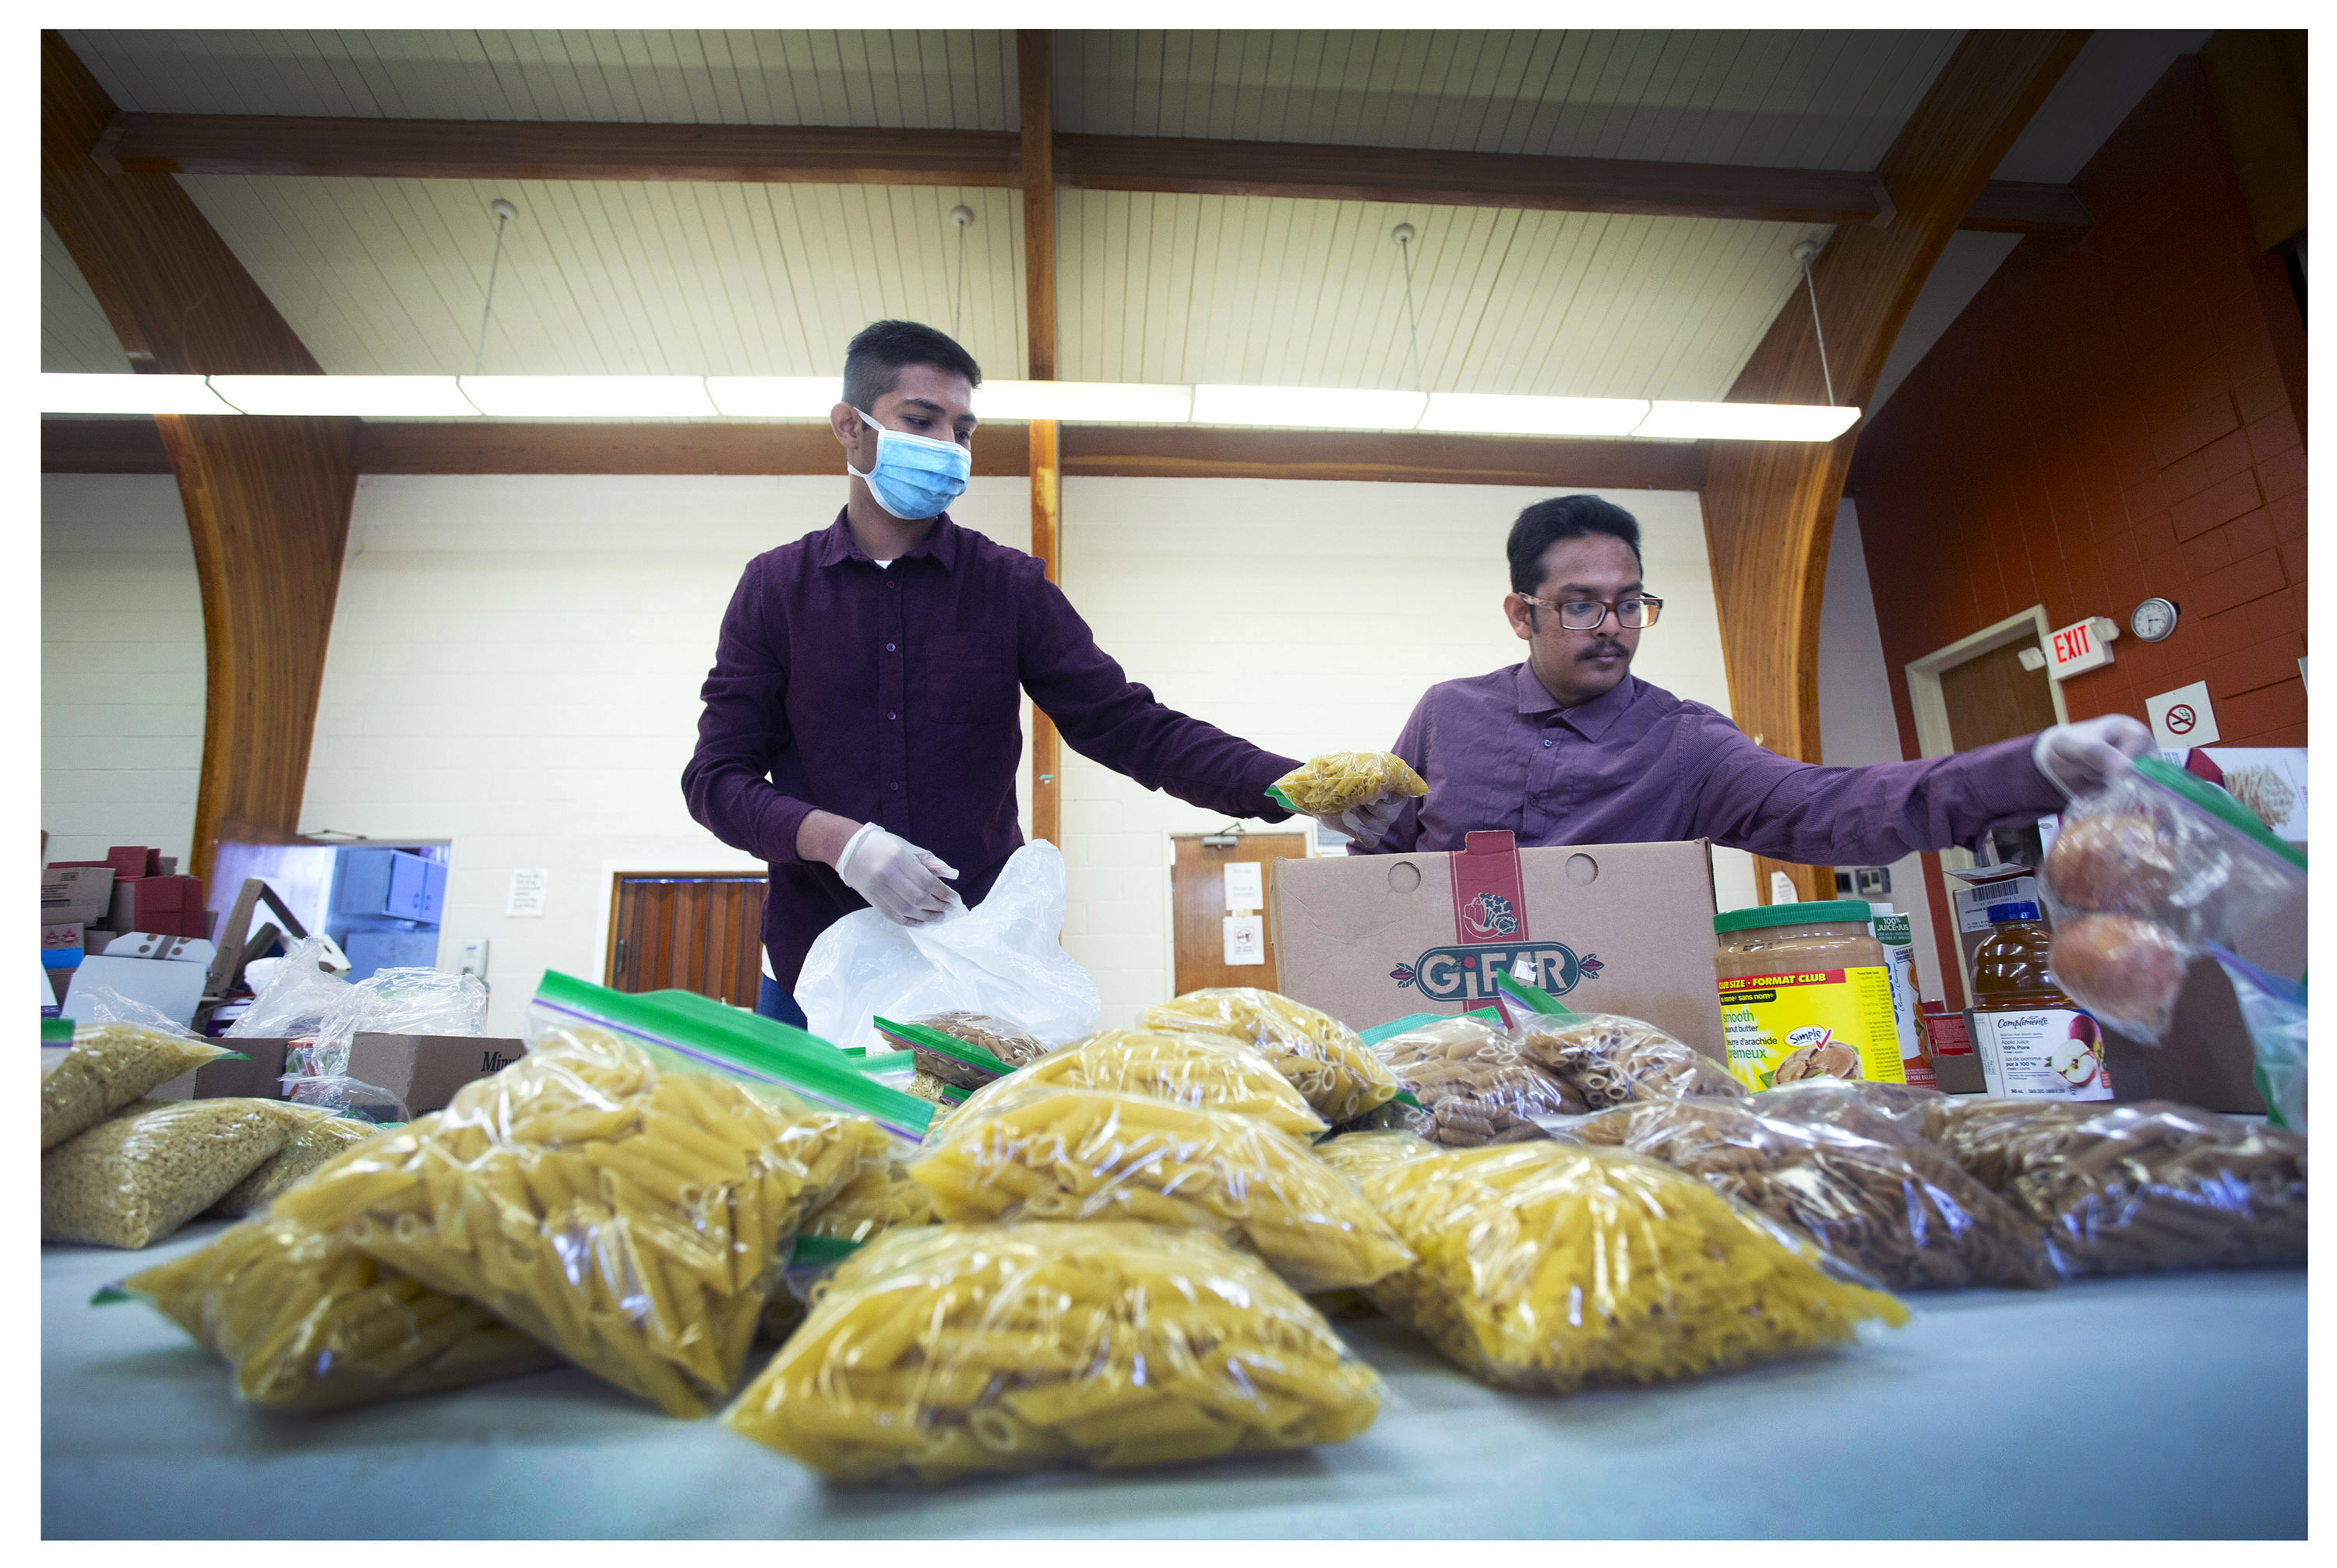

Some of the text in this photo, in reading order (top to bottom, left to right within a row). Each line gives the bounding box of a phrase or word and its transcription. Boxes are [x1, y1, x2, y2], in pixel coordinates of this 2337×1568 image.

[2053, 624, 2090, 664] EXIT
[1729, 979, 1746, 988] SIZE
[1752, 975, 1796, 987] FORMAT
[1798, 973, 1827, 983] CLUB
[1722, 1009, 1755, 1023] smooth
[1738, 1024, 1759, 1033] butter
[1997, 1017, 2050, 1030] Compliments
[1740, 1037, 1778, 1046] d'arachide
[1789, 1028, 1822, 1044] Simple
